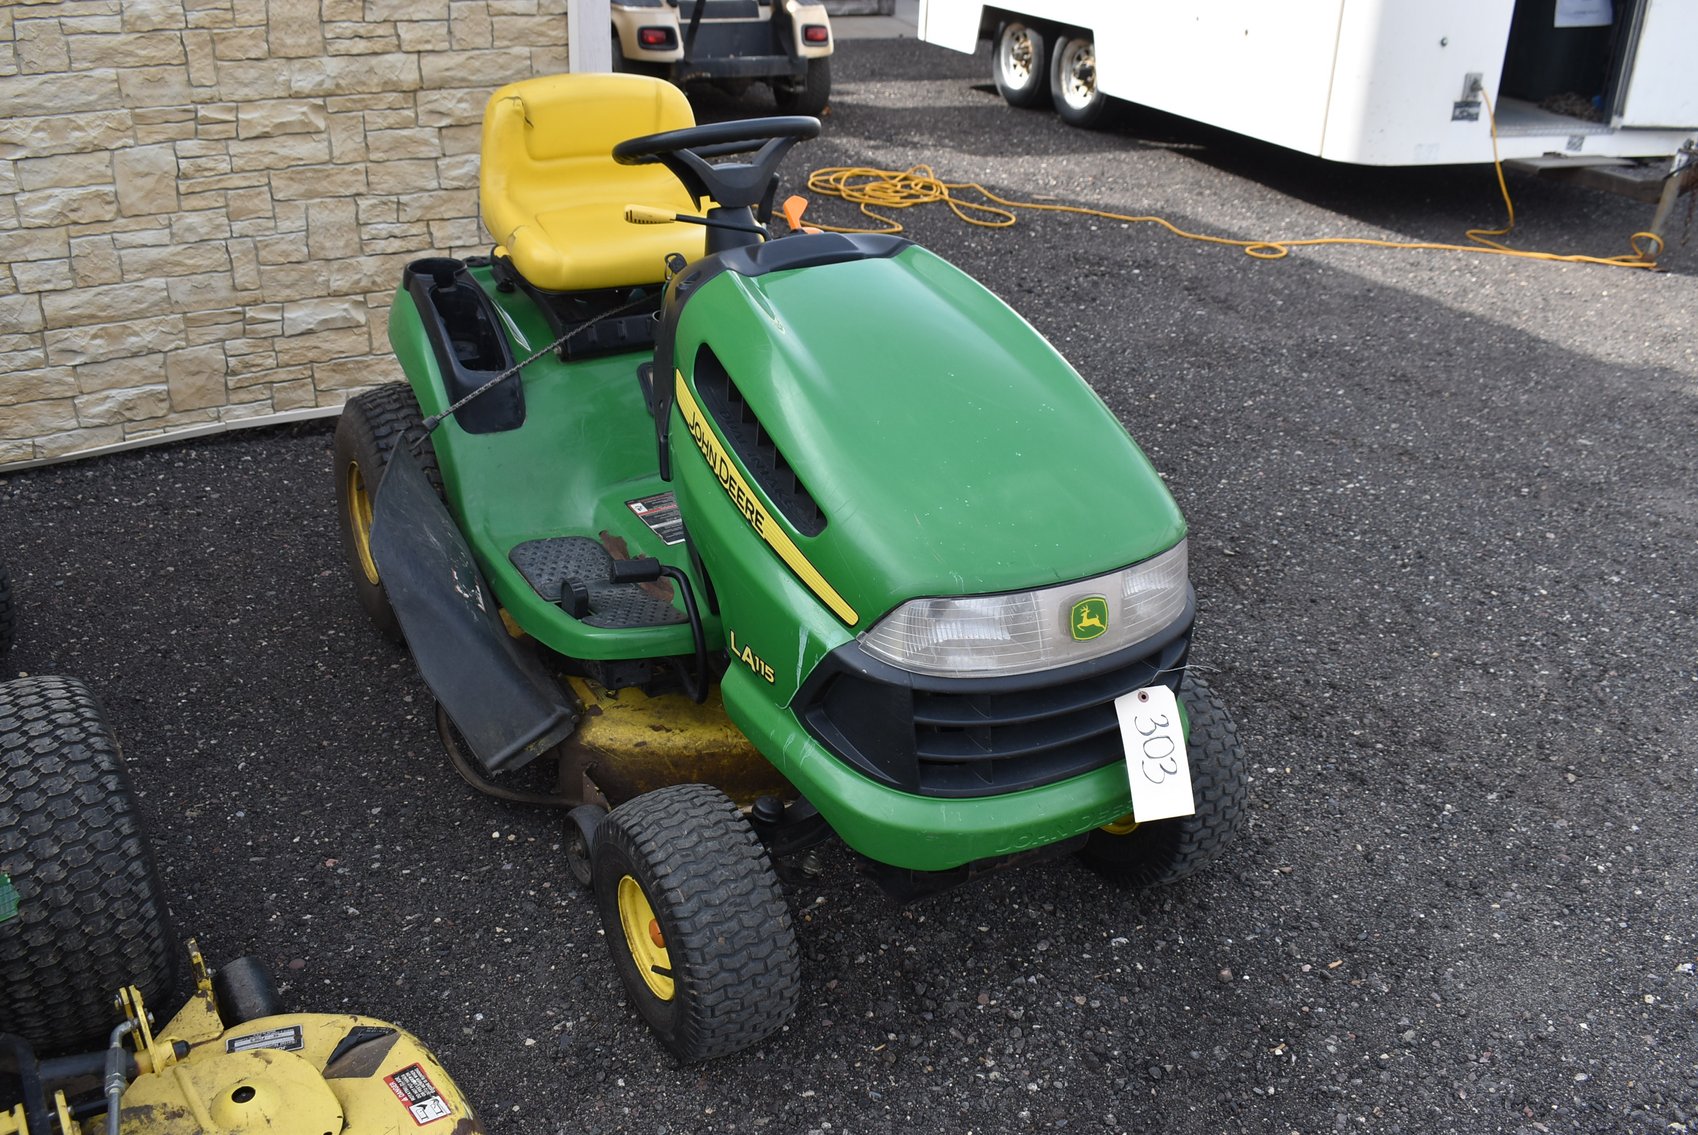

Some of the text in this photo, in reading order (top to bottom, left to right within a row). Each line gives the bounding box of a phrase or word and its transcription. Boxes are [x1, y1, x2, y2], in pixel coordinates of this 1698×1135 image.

[689, 411, 765, 535] JOHN DEERE
[730, 629, 775, 683] LA115
[1134, 714, 1178, 784] 303
[1074, 800, 1132, 833] DEER
